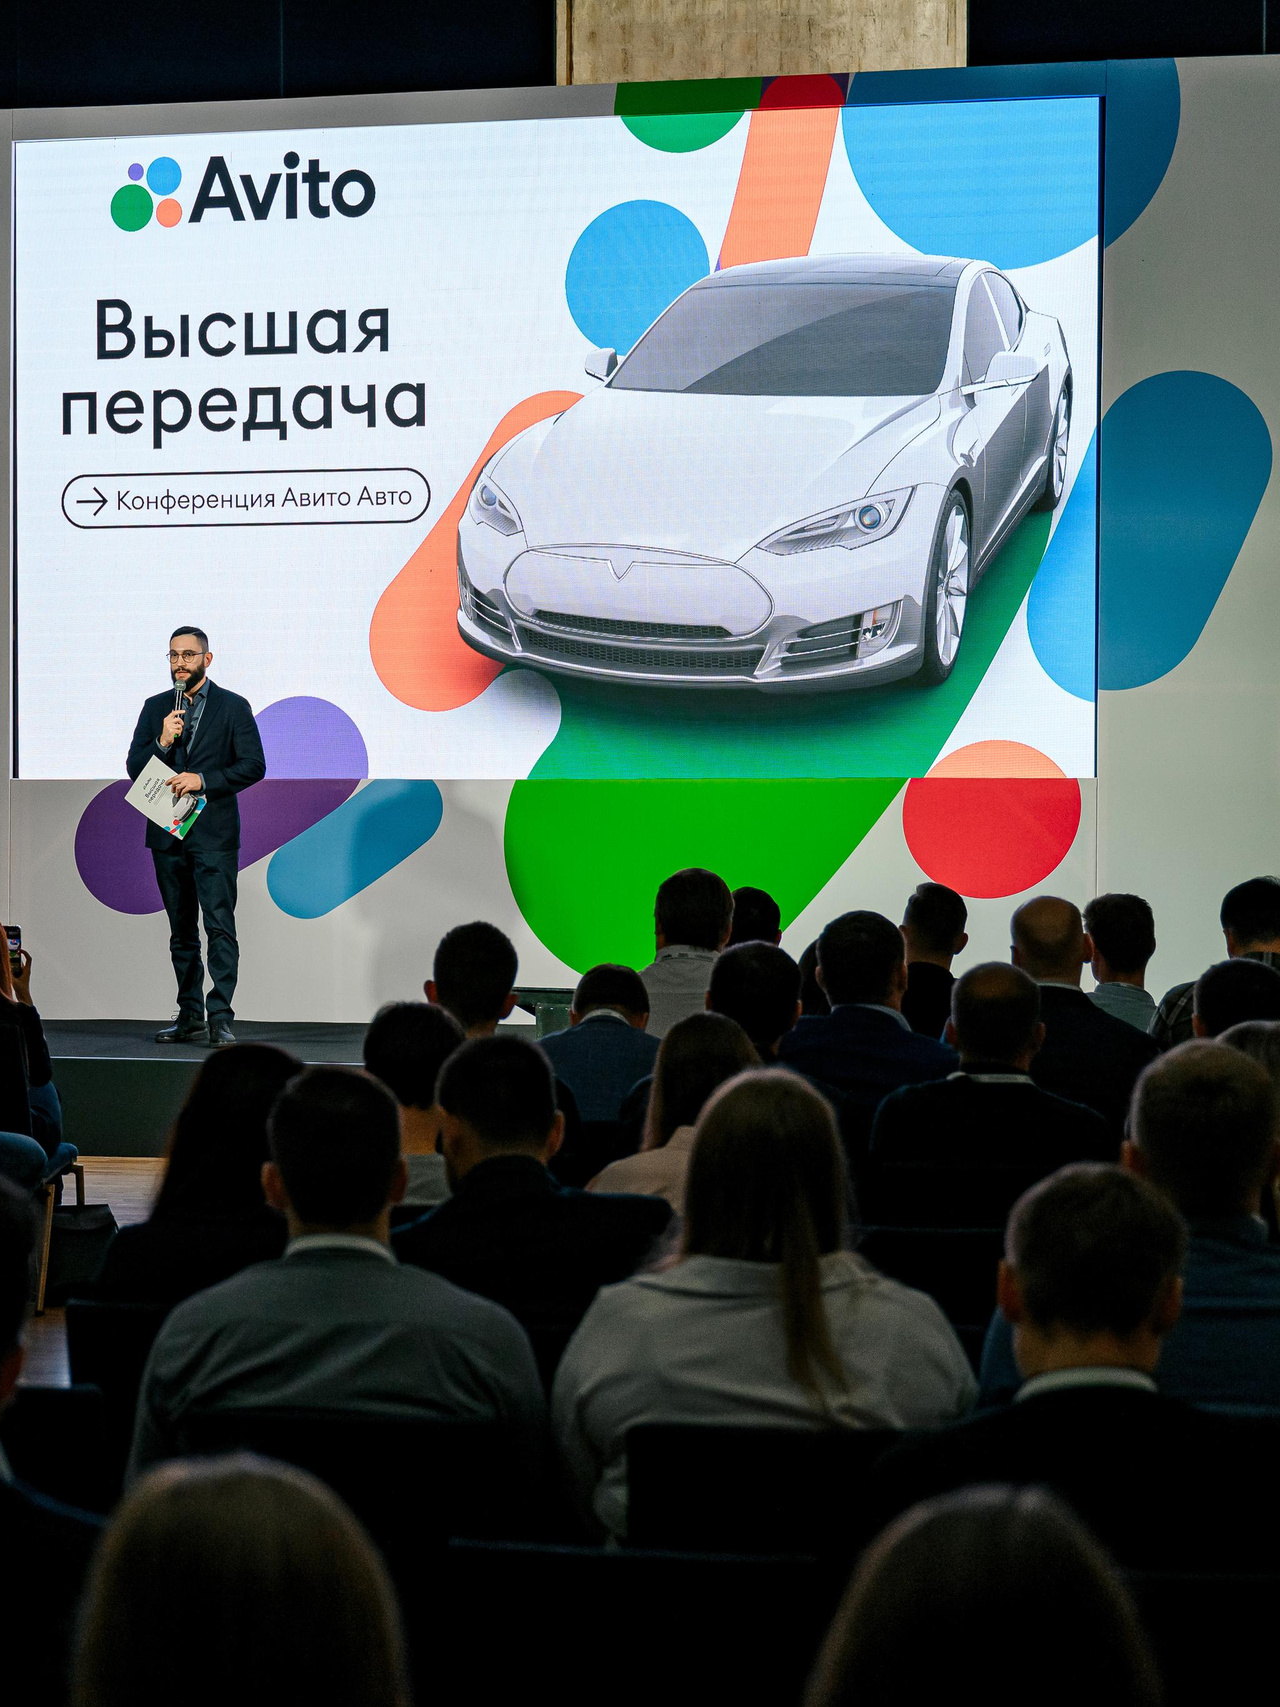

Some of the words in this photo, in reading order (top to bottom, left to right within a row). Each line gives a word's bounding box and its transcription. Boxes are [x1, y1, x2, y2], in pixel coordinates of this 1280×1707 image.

[188, 151, 376, 223] Avito
[96, 298, 389, 360] Высшая
[62, 382, 426, 450] передача
[116, 488, 275, 515] Конференция
[281, 487, 351, 509] Авито
[356, 485, 412, 507] Авто
